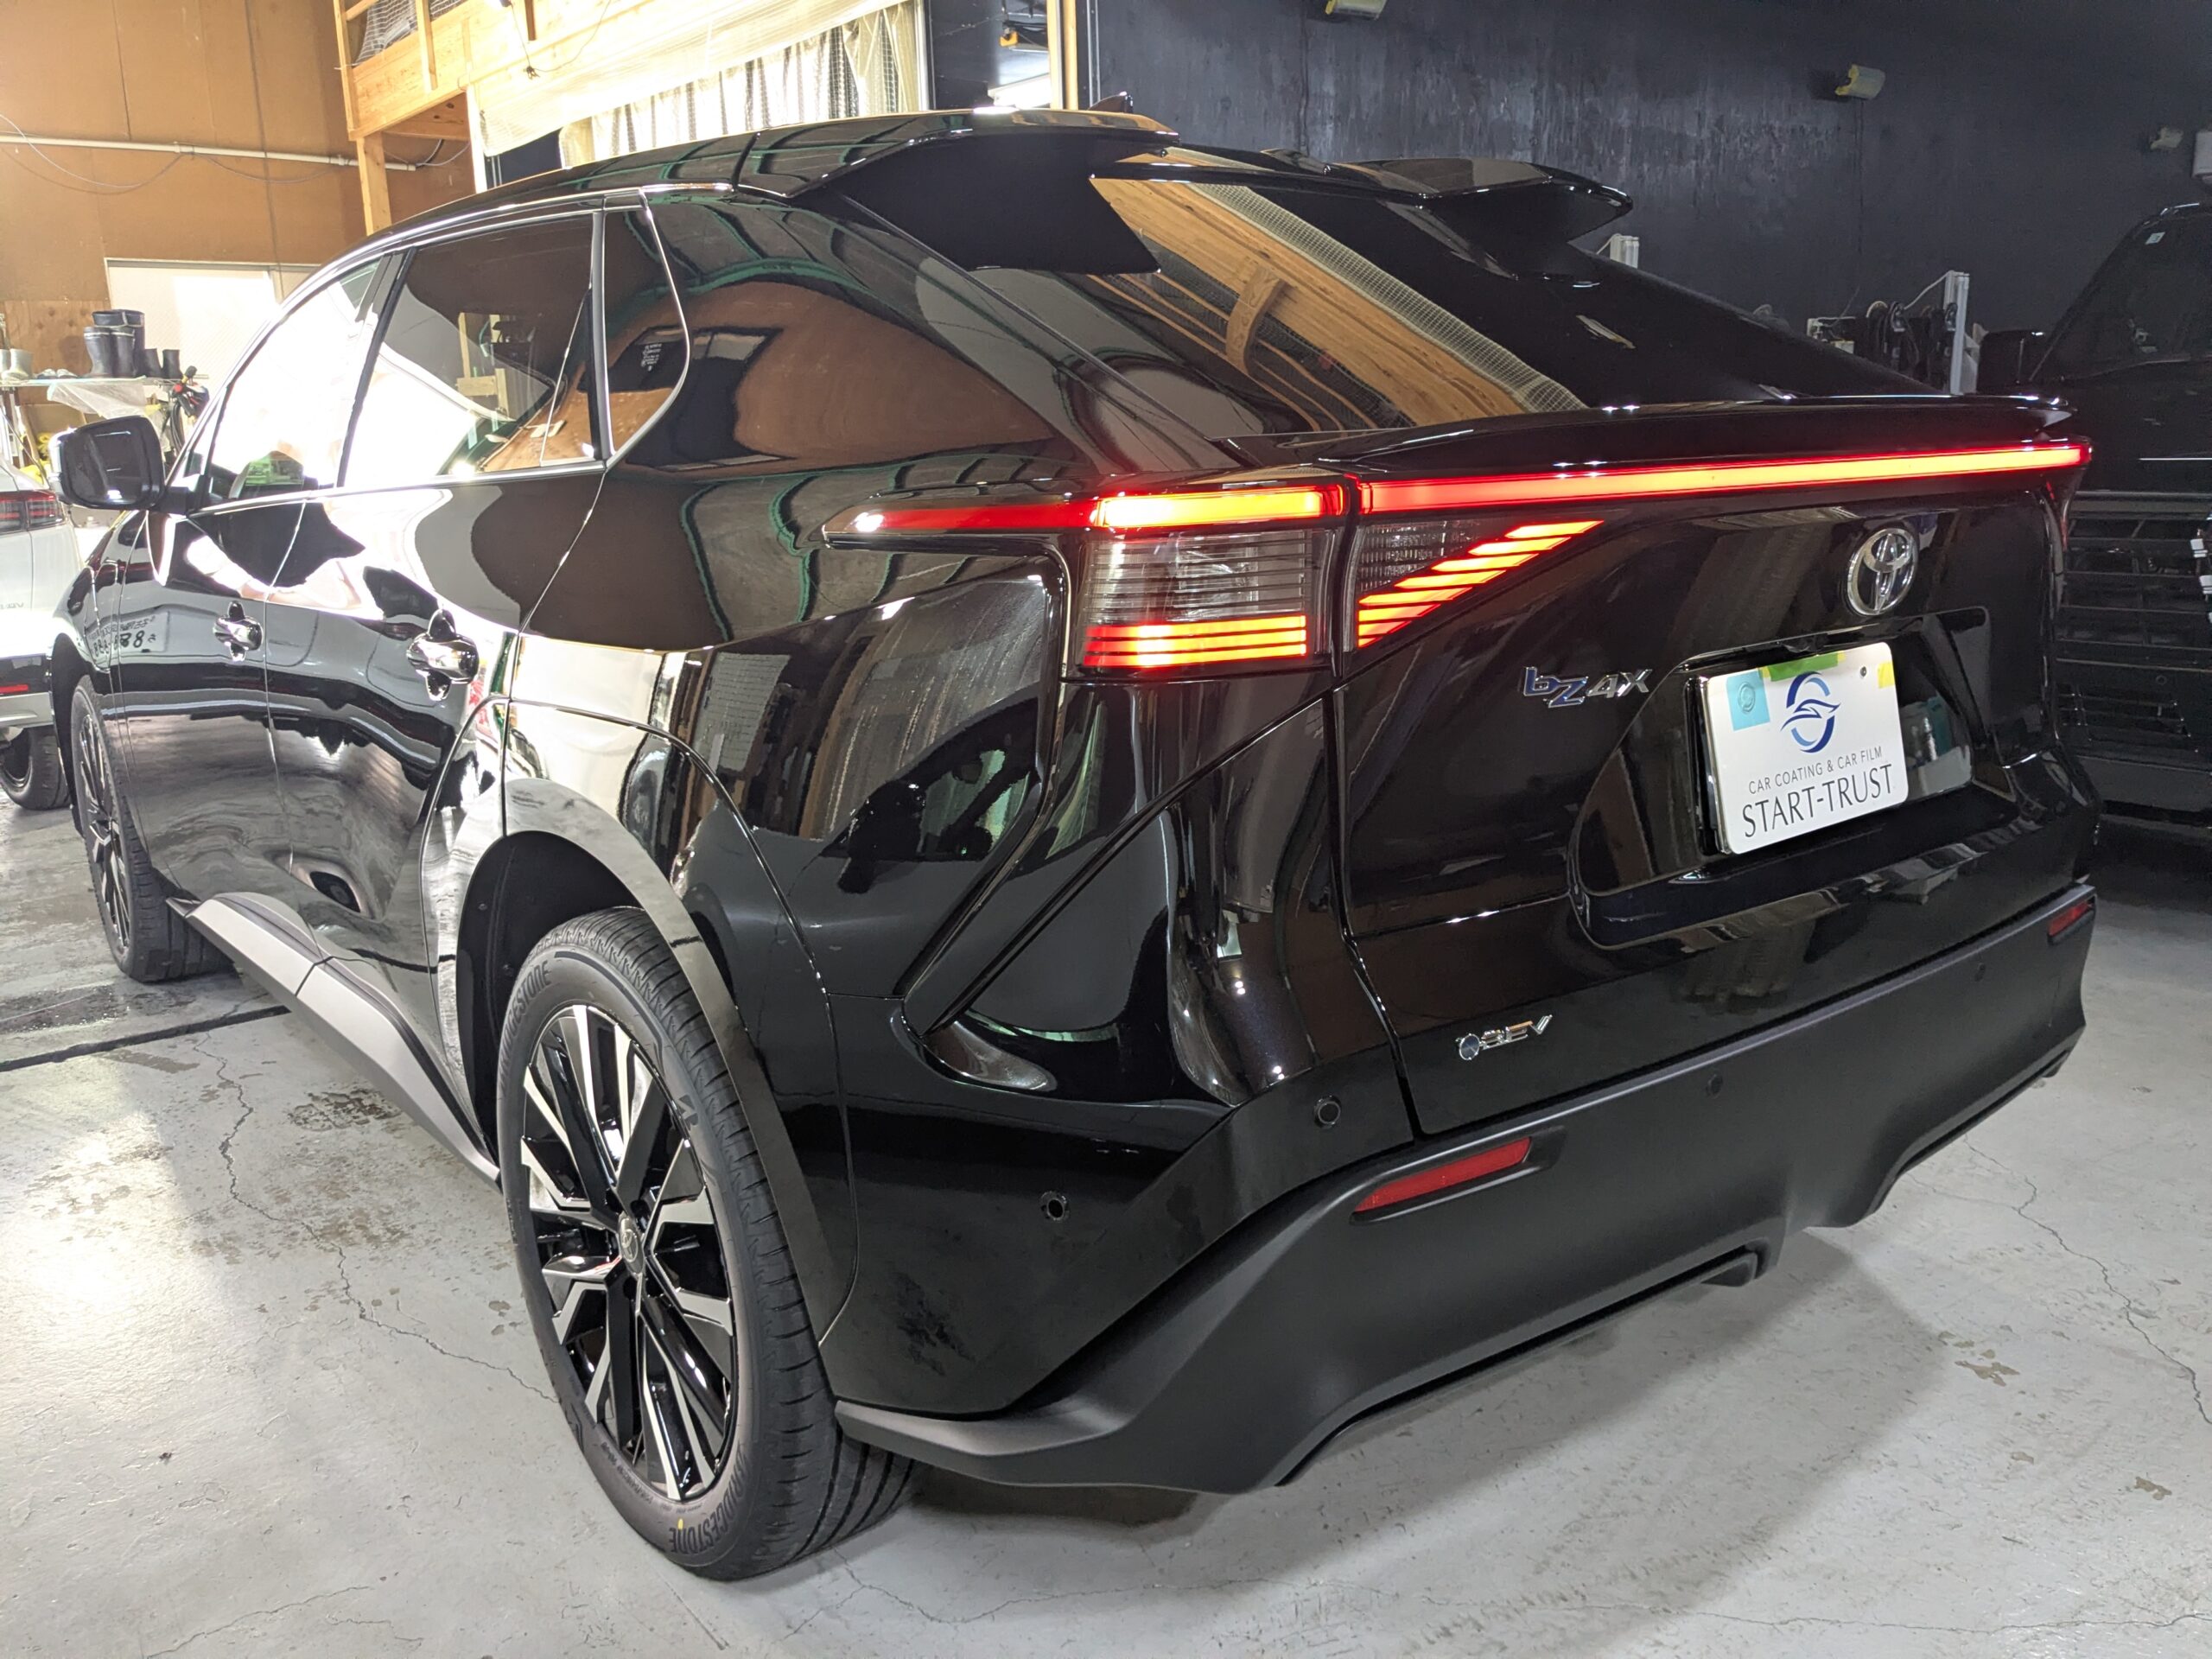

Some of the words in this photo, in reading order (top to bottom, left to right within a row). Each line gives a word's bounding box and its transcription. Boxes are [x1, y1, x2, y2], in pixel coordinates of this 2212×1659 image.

[1748, 777, 1771, 794] CAR
[1775, 763, 1823, 785] COATING
[1827, 760, 1834, 772] &
[1838, 753, 1858, 769] CAR
[1860, 746, 1883, 764] FILM
[1742, 764, 1892, 837] START-TRUST
